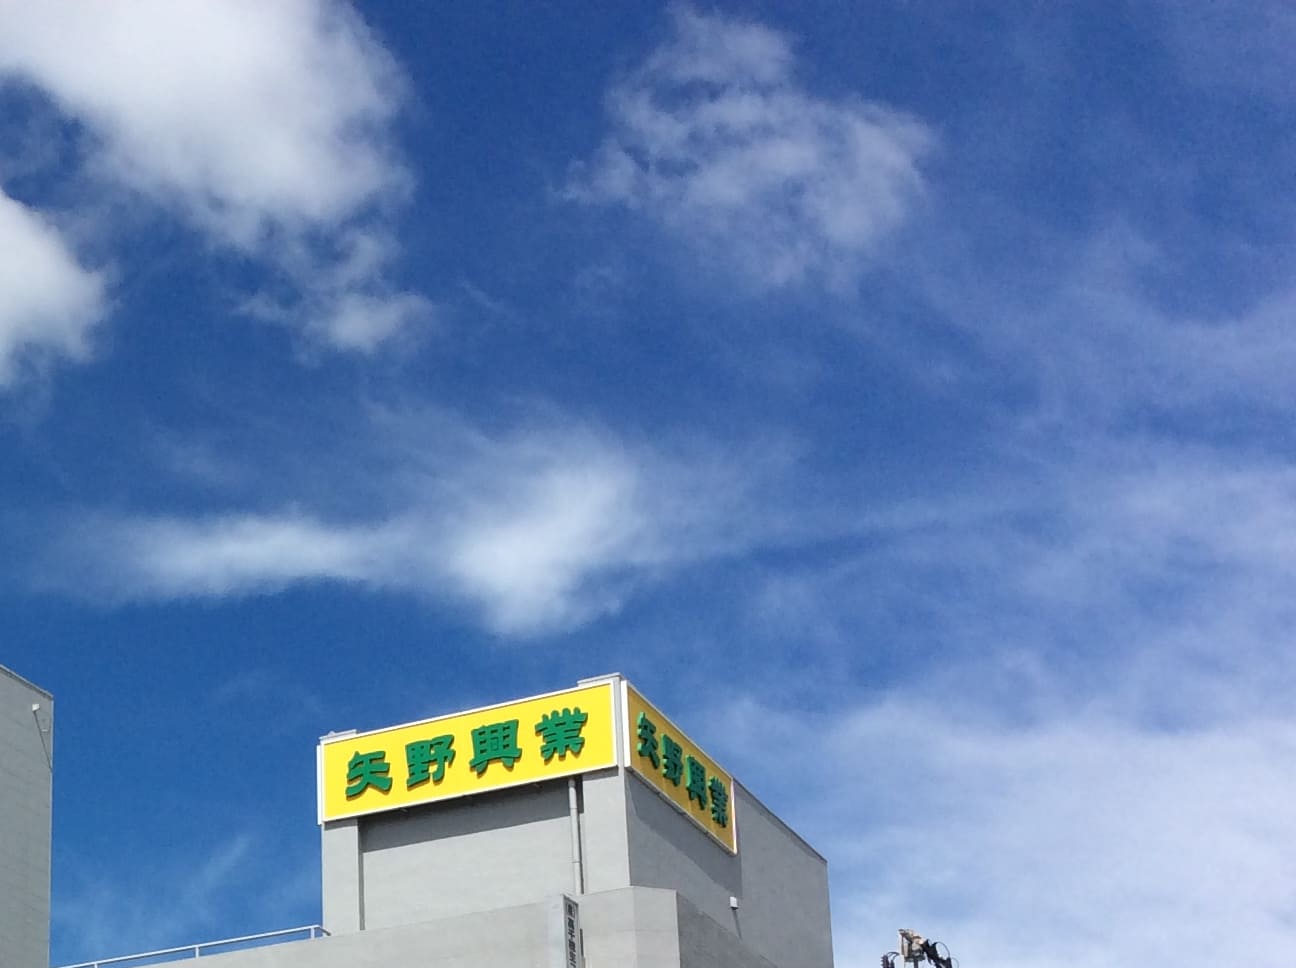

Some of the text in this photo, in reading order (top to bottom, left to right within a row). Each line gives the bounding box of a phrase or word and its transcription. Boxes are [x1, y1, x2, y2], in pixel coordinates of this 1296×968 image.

[344, 706, 590, 800] 矢野興業
[635, 711, 730, 828] 矢野興業
